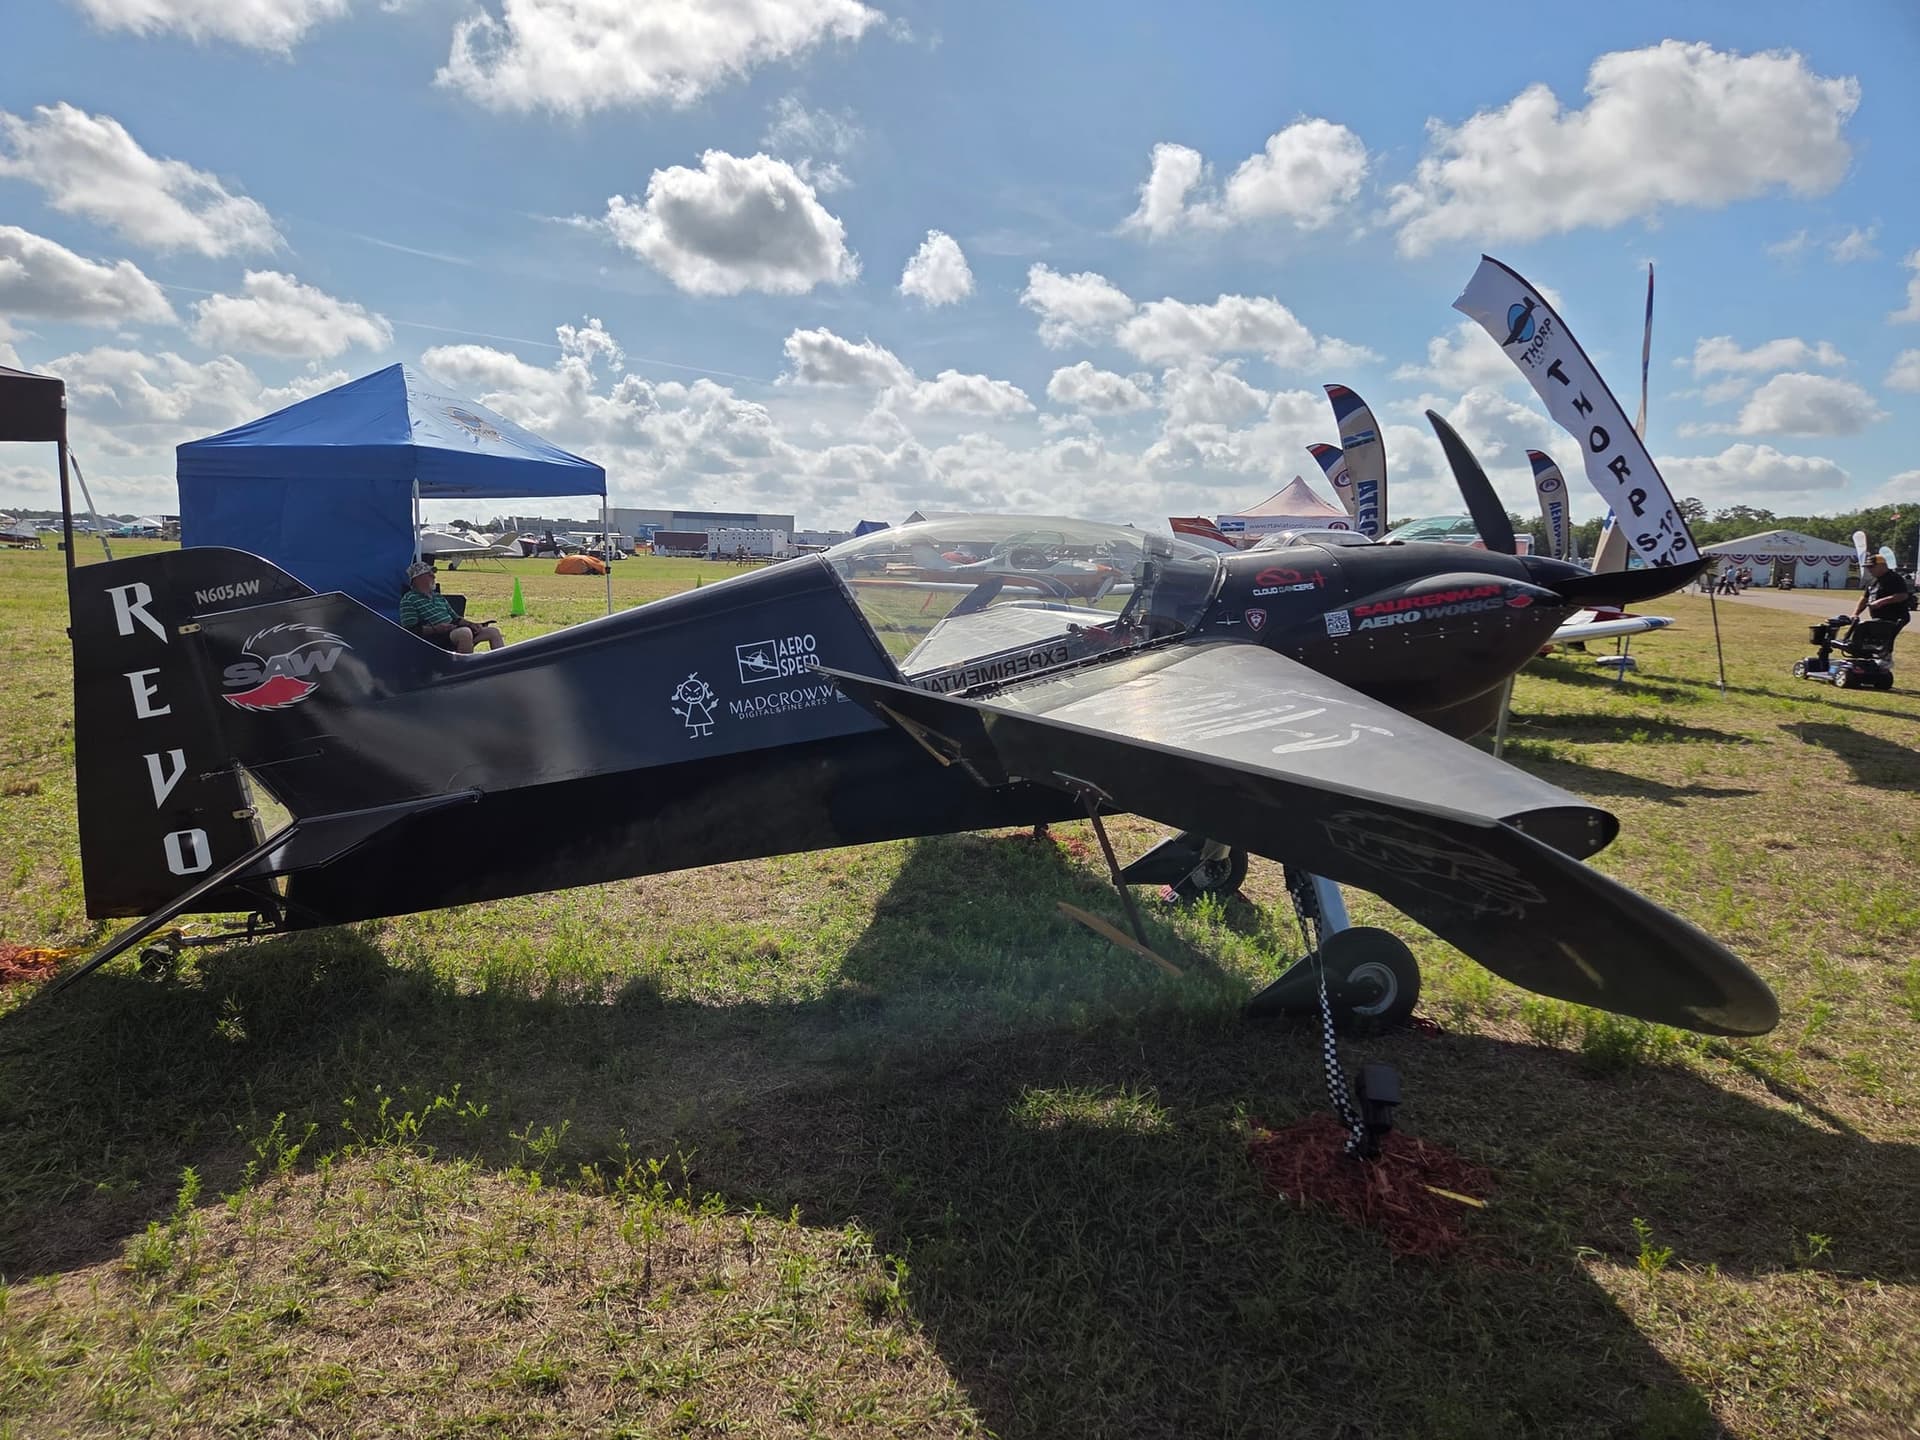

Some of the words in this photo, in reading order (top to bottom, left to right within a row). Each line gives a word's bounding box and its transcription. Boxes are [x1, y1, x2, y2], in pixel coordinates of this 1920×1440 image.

[1520, 318, 1551, 364] THORP
[1547, 358, 1647, 517] THORP
[1357, 480, 1378, 537] ATEC
[195, 579, 260, 605] N605AW
[1252, 587, 1278, 596] CLOUD
[1279, 583, 1315, 593] DANCERS
[1358, 610, 1421, 631] AERO
[1423, 598, 1504, 619] WORKS
[779, 634, 816, 657] AERO
[222, 647, 343, 686] SAW
[780, 653, 820, 677] SPEED
[738, 708, 775, 720] DIGITAL
[782, 702, 803, 712] FINE
[804, 698, 828, 709] ARTS
[104, 582, 213, 875] REVO
